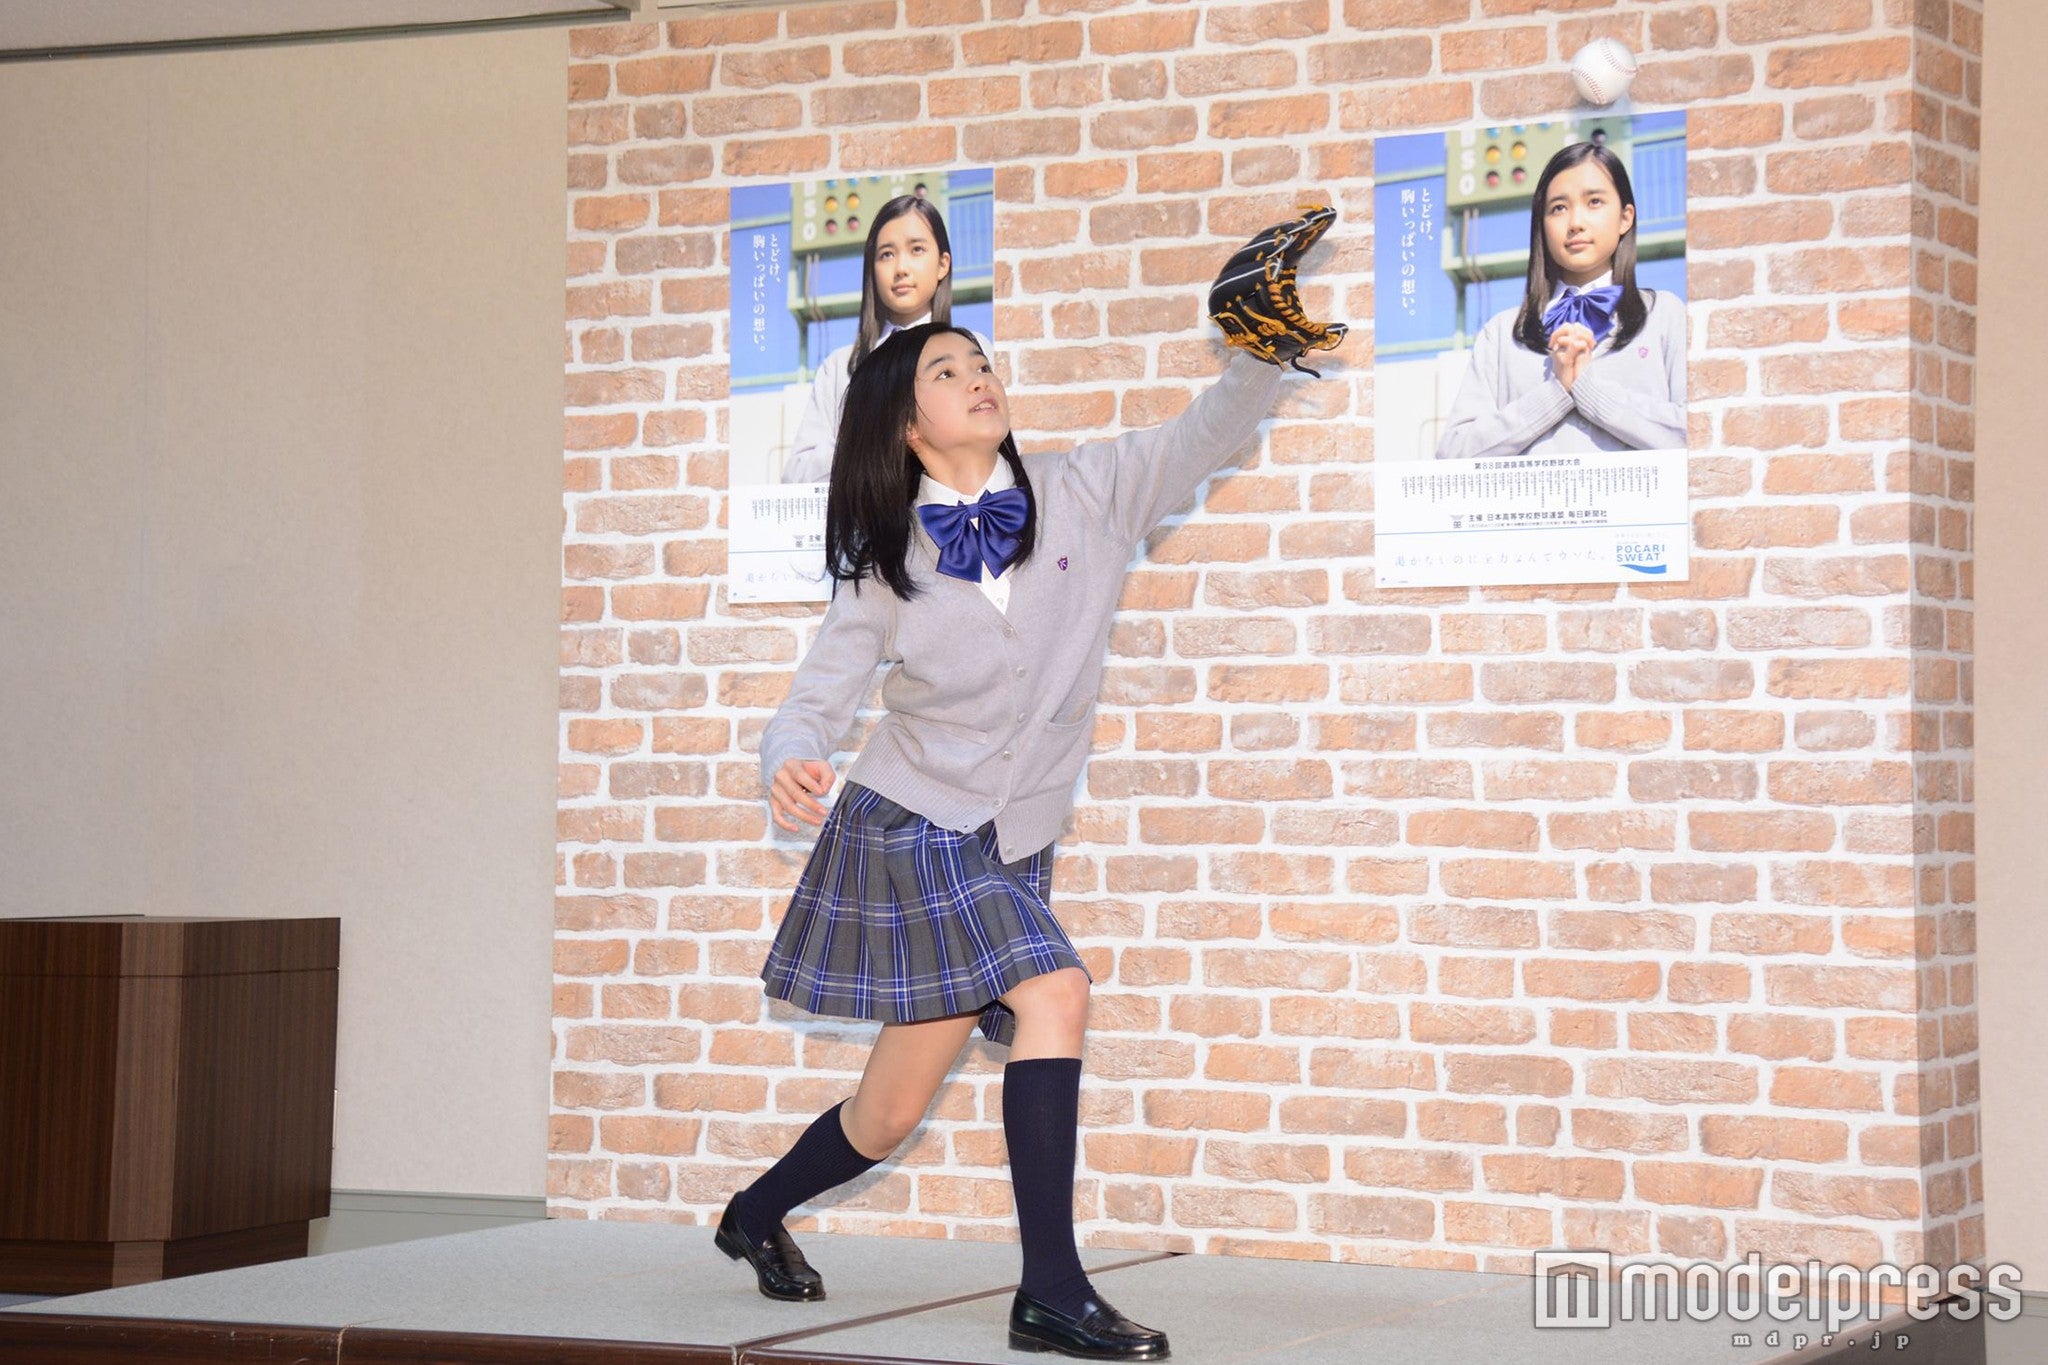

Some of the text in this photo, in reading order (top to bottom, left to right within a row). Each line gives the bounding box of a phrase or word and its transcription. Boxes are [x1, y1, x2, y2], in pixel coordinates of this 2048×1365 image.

[1420, 187, 1433, 240] とどけ、
[1401, 189, 1416, 316] 胸いっぱいの想い。
[1616, 544, 1666, 554] POCARI
[1616, 553, 1661, 562] SWEAT
